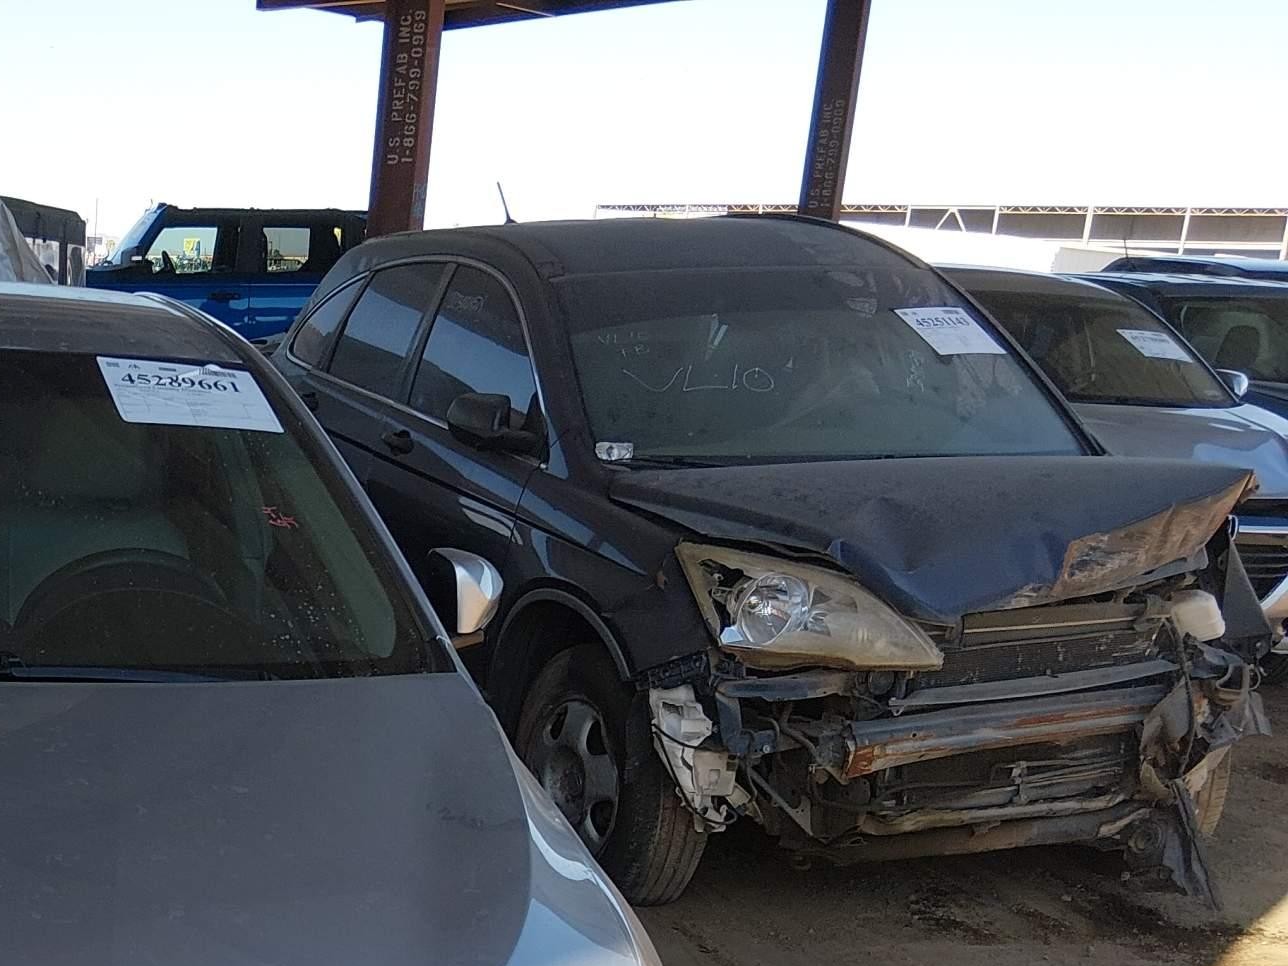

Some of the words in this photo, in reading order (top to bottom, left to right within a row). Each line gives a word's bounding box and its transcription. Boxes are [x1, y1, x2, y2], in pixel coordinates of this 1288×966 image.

[399, 9, 413, 44] INC.
[392, 53, 409, 122] PREFAB
[121, 372, 241, 394] 45289661
